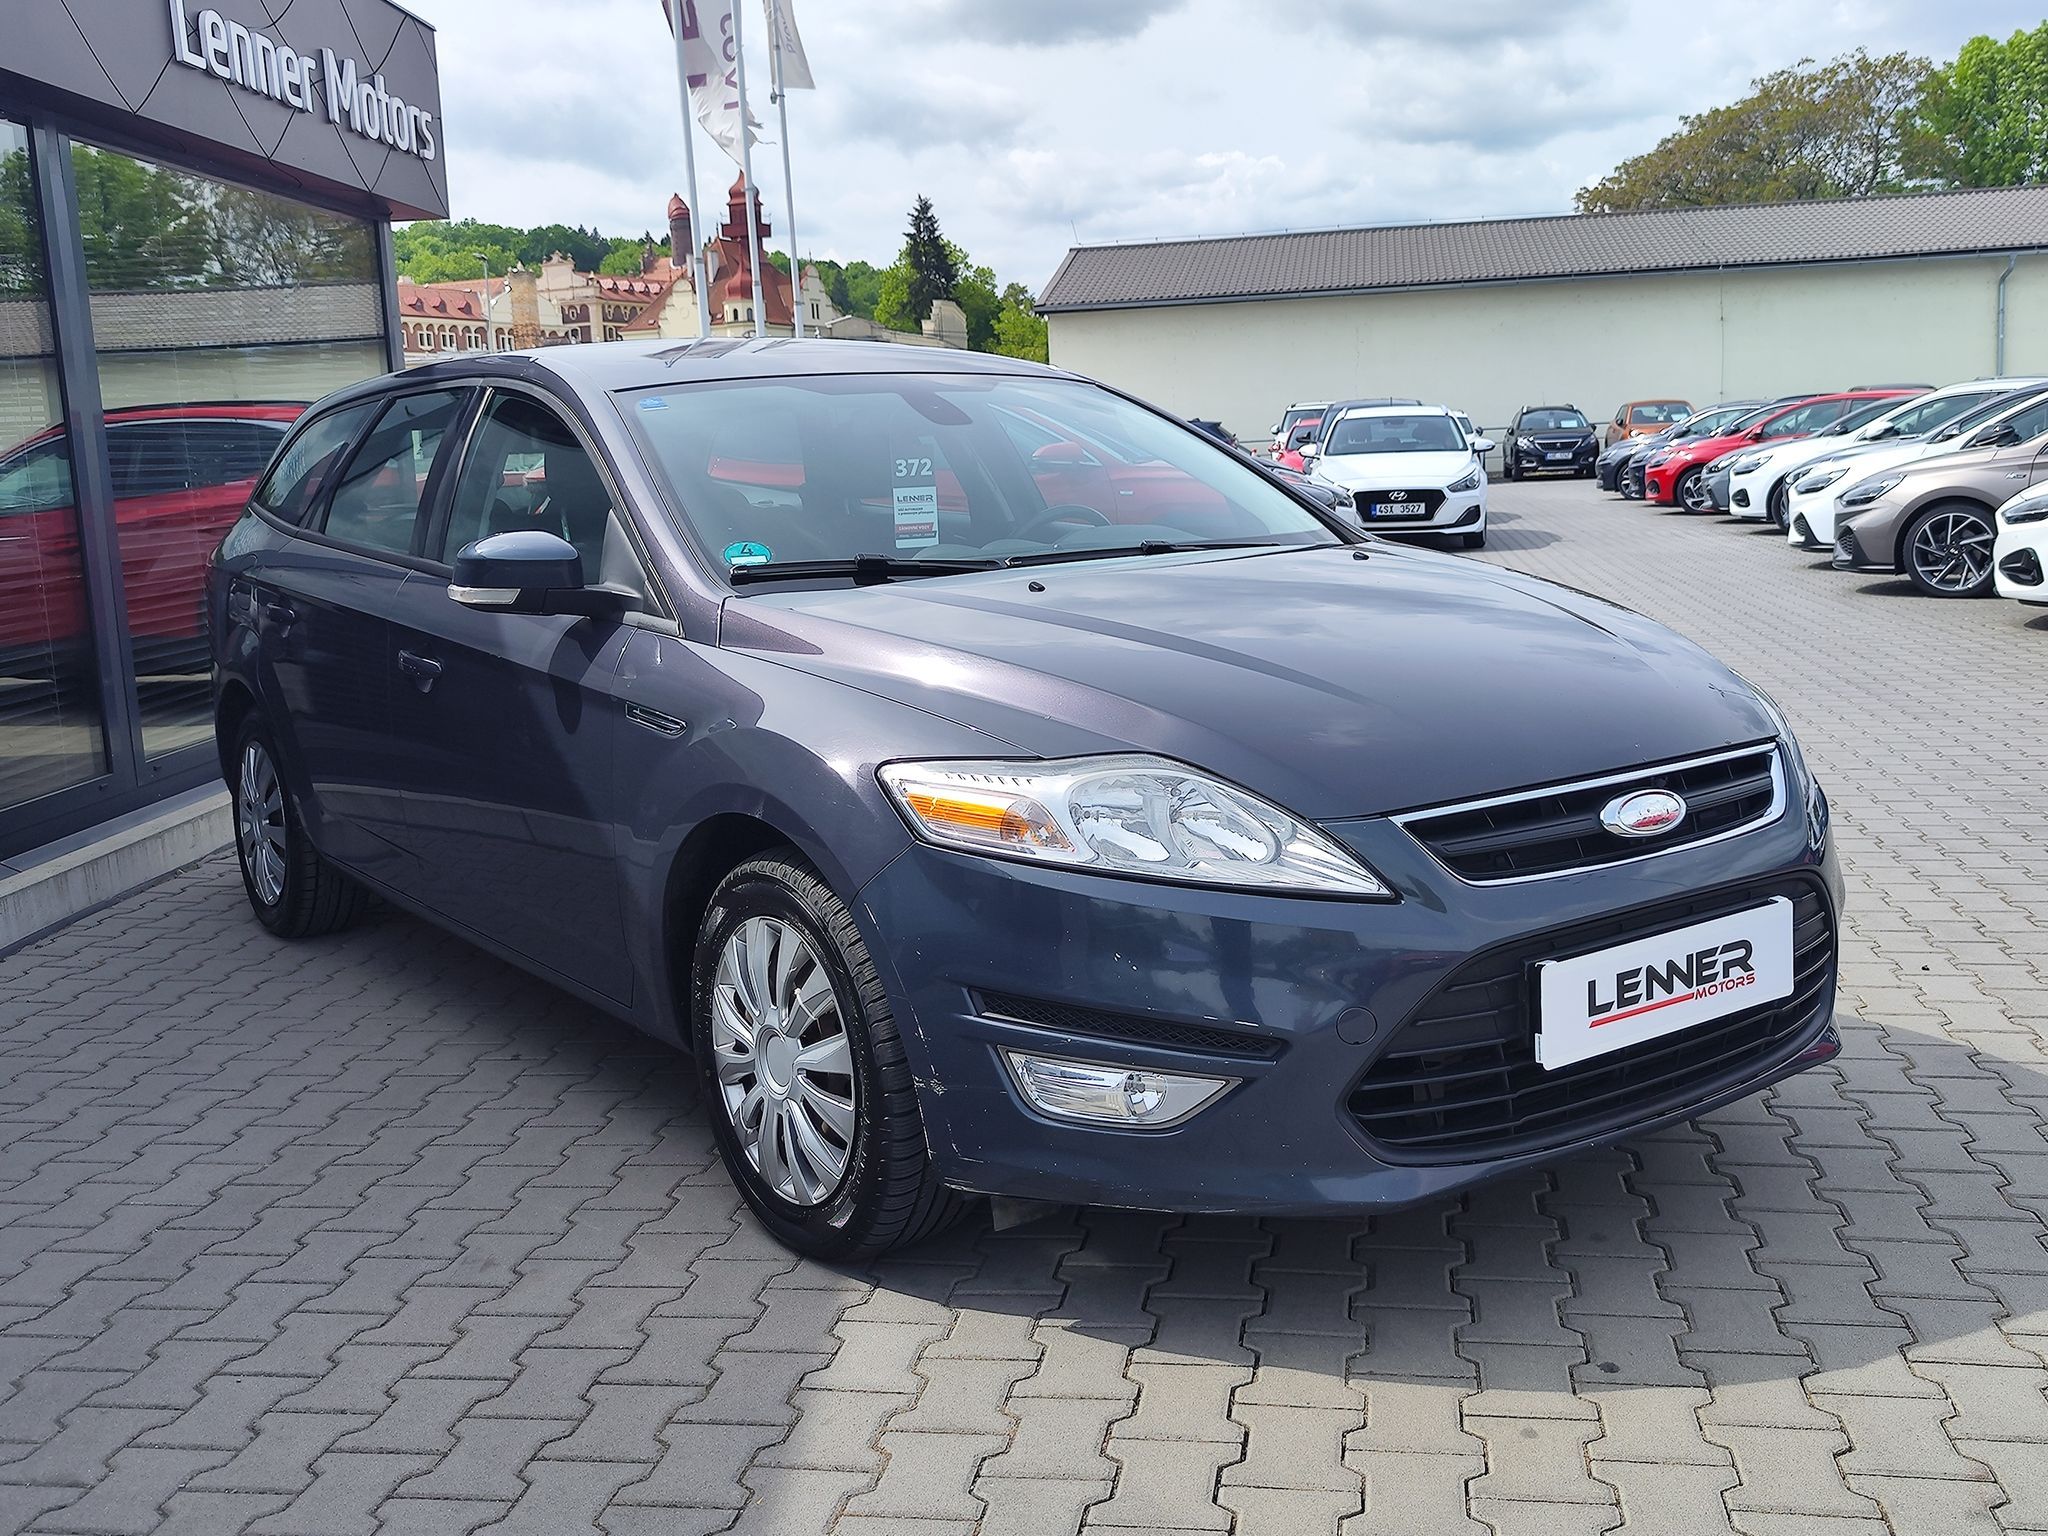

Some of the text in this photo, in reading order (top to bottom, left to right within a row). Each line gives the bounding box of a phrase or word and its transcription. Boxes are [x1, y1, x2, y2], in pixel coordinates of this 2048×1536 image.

[168, 0, 437, 161] Lenner Motors
[895, 457, 933, 477] 372
[1379, 504, 1421, 514] 4SX 3527
[740, 543, 754, 557] 4
[1588, 939, 1755, 1017] LENNER
[1694, 972, 1756, 1001] MOTORS
